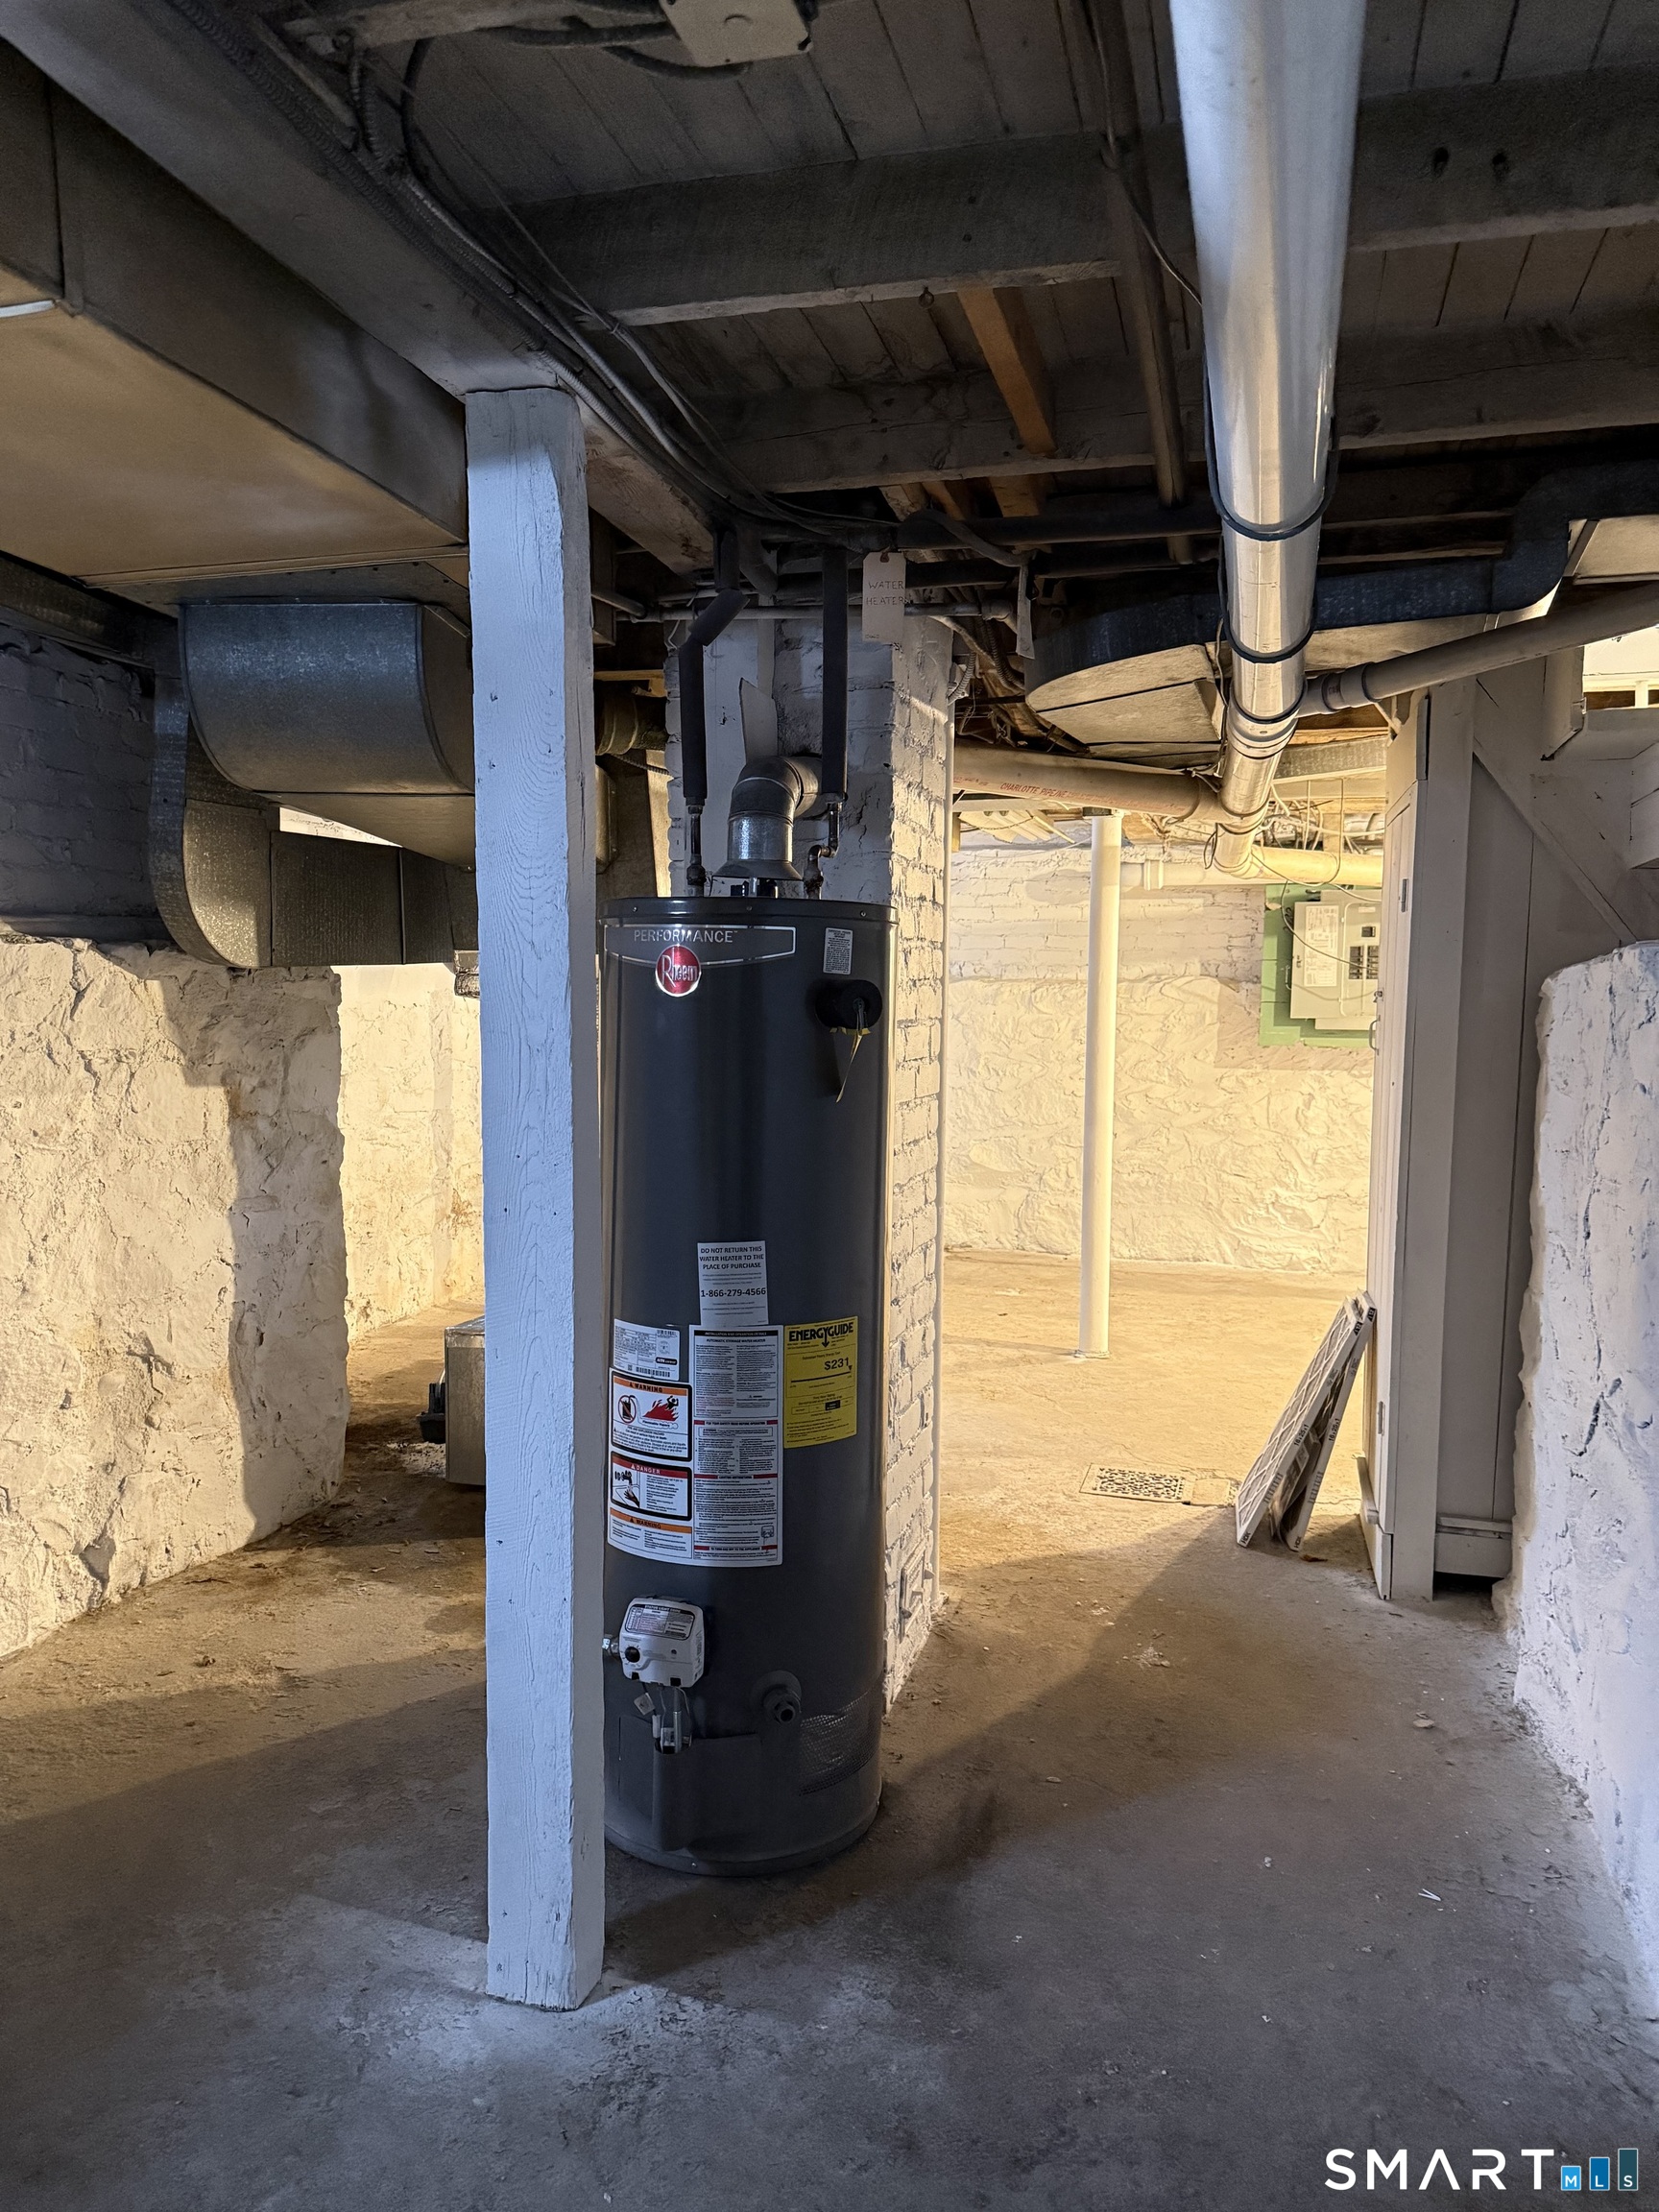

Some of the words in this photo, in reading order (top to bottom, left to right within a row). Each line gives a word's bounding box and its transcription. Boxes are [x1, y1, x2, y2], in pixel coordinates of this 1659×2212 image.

[868, 580, 904, 590] WATER
[866, 596, 905, 606] HEATER
[999, 782, 1040, 795] CHARLOTTE
[661, 947, 698, 988] Rheem
[701, 1287, 766, 1297] 1-866-279-4566
[789, 1322, 854, 1343] ENERGYGUIDE
[825, 1357, 849, 1371] $231
[635, 1382, 663, 1393] WARNING
[637, 1466, 661, 1475] DANGER
[637, 1519, 661, 1529] WARNING
